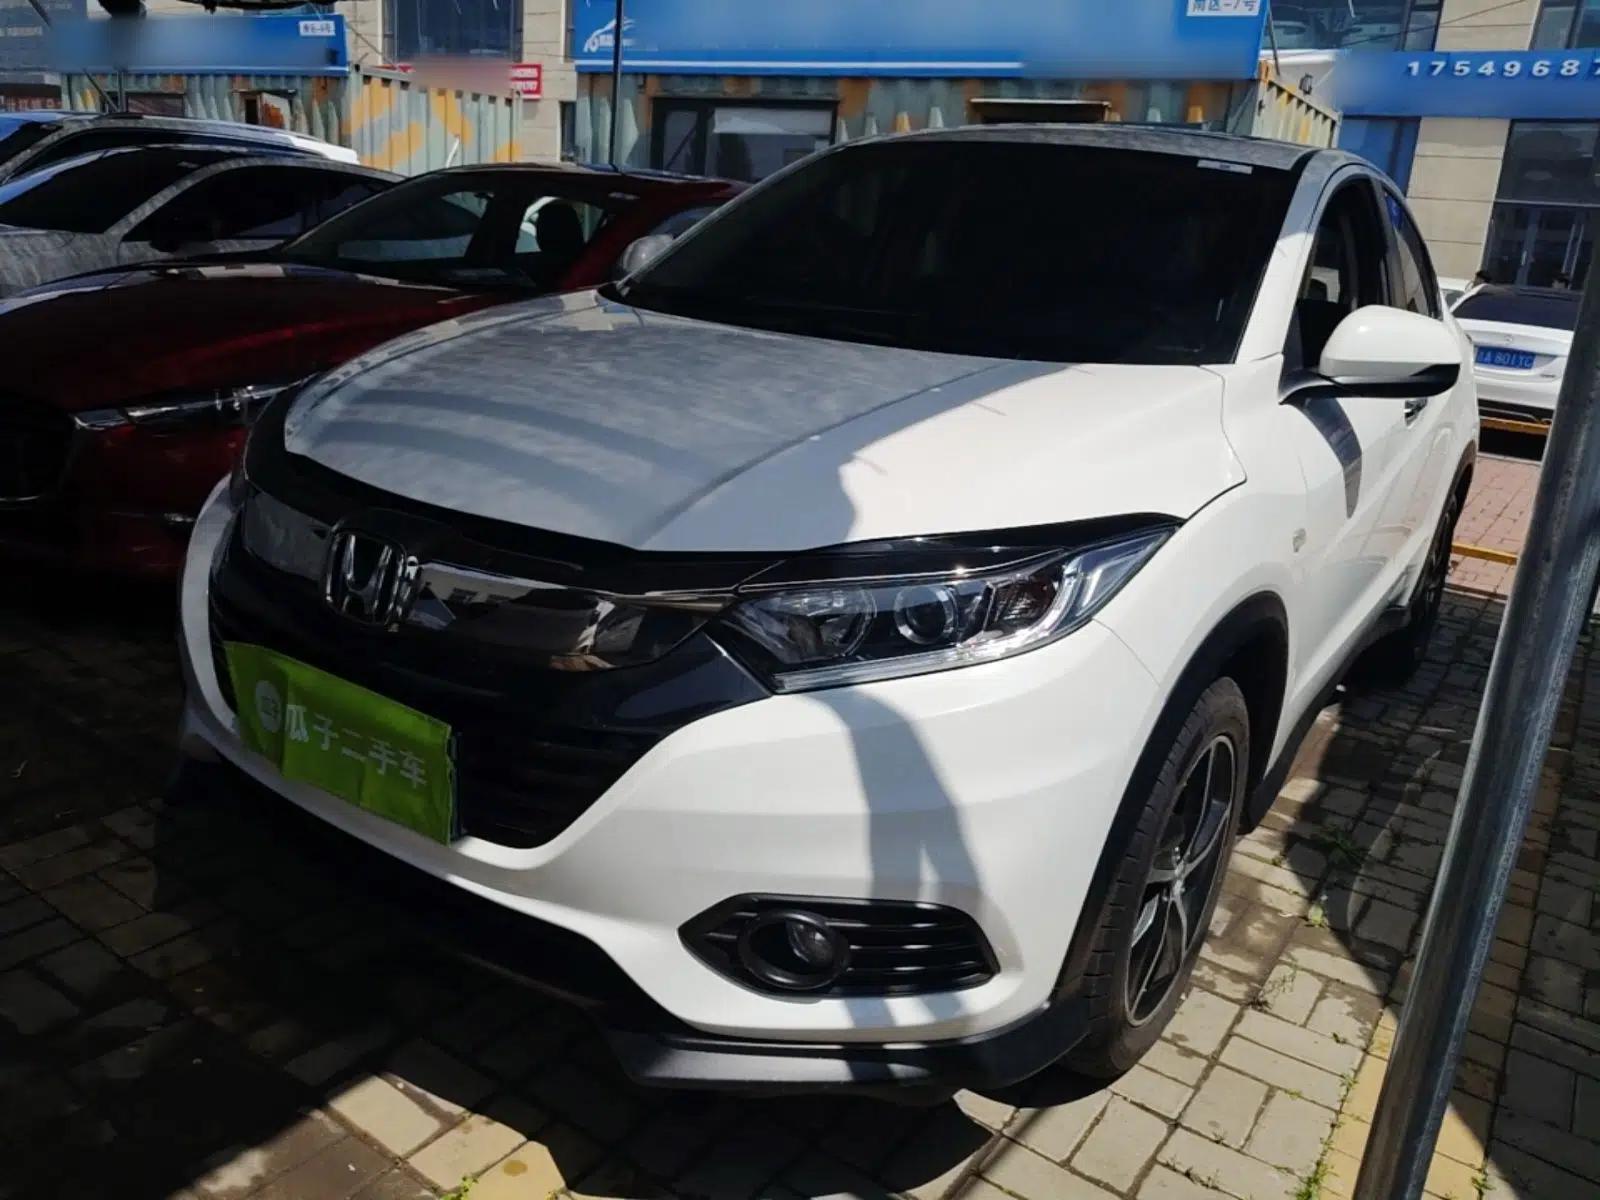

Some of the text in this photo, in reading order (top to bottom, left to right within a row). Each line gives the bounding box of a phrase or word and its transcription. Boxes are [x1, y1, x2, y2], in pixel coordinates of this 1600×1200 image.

[285, 703, 427, 789] 瓜子二手车
